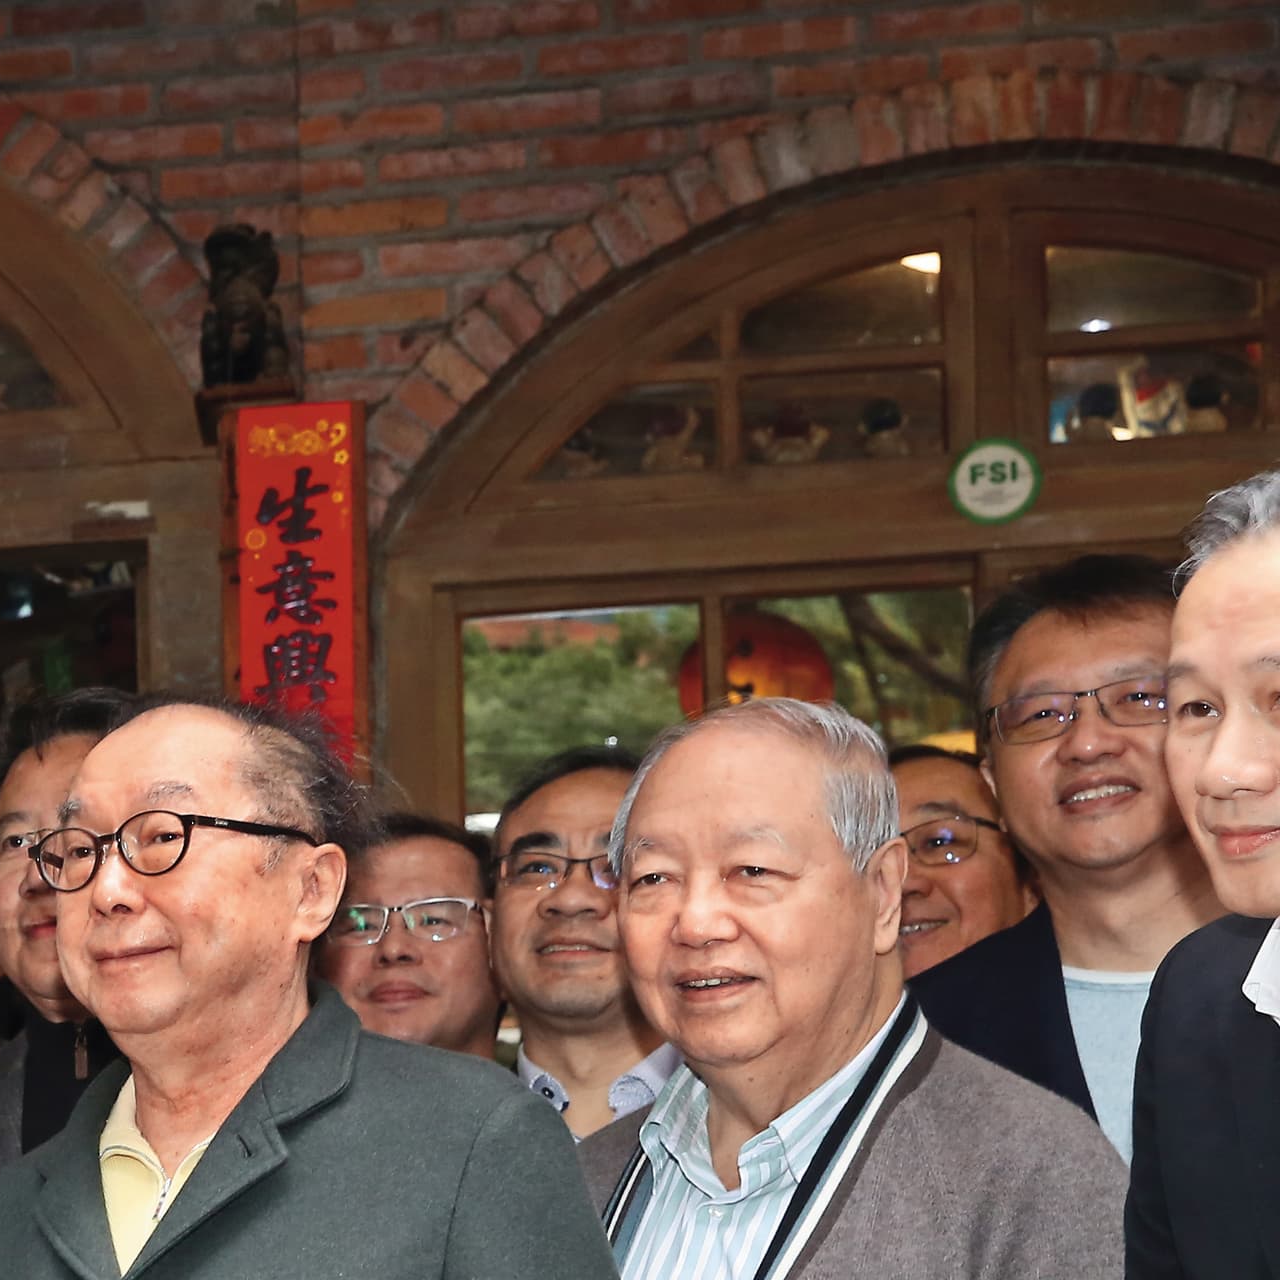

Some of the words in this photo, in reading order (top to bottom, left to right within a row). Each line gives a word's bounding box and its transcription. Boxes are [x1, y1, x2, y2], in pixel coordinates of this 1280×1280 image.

[969, 460, 1018, 486] FSI
[255, 466, 337, 702] 生意興
